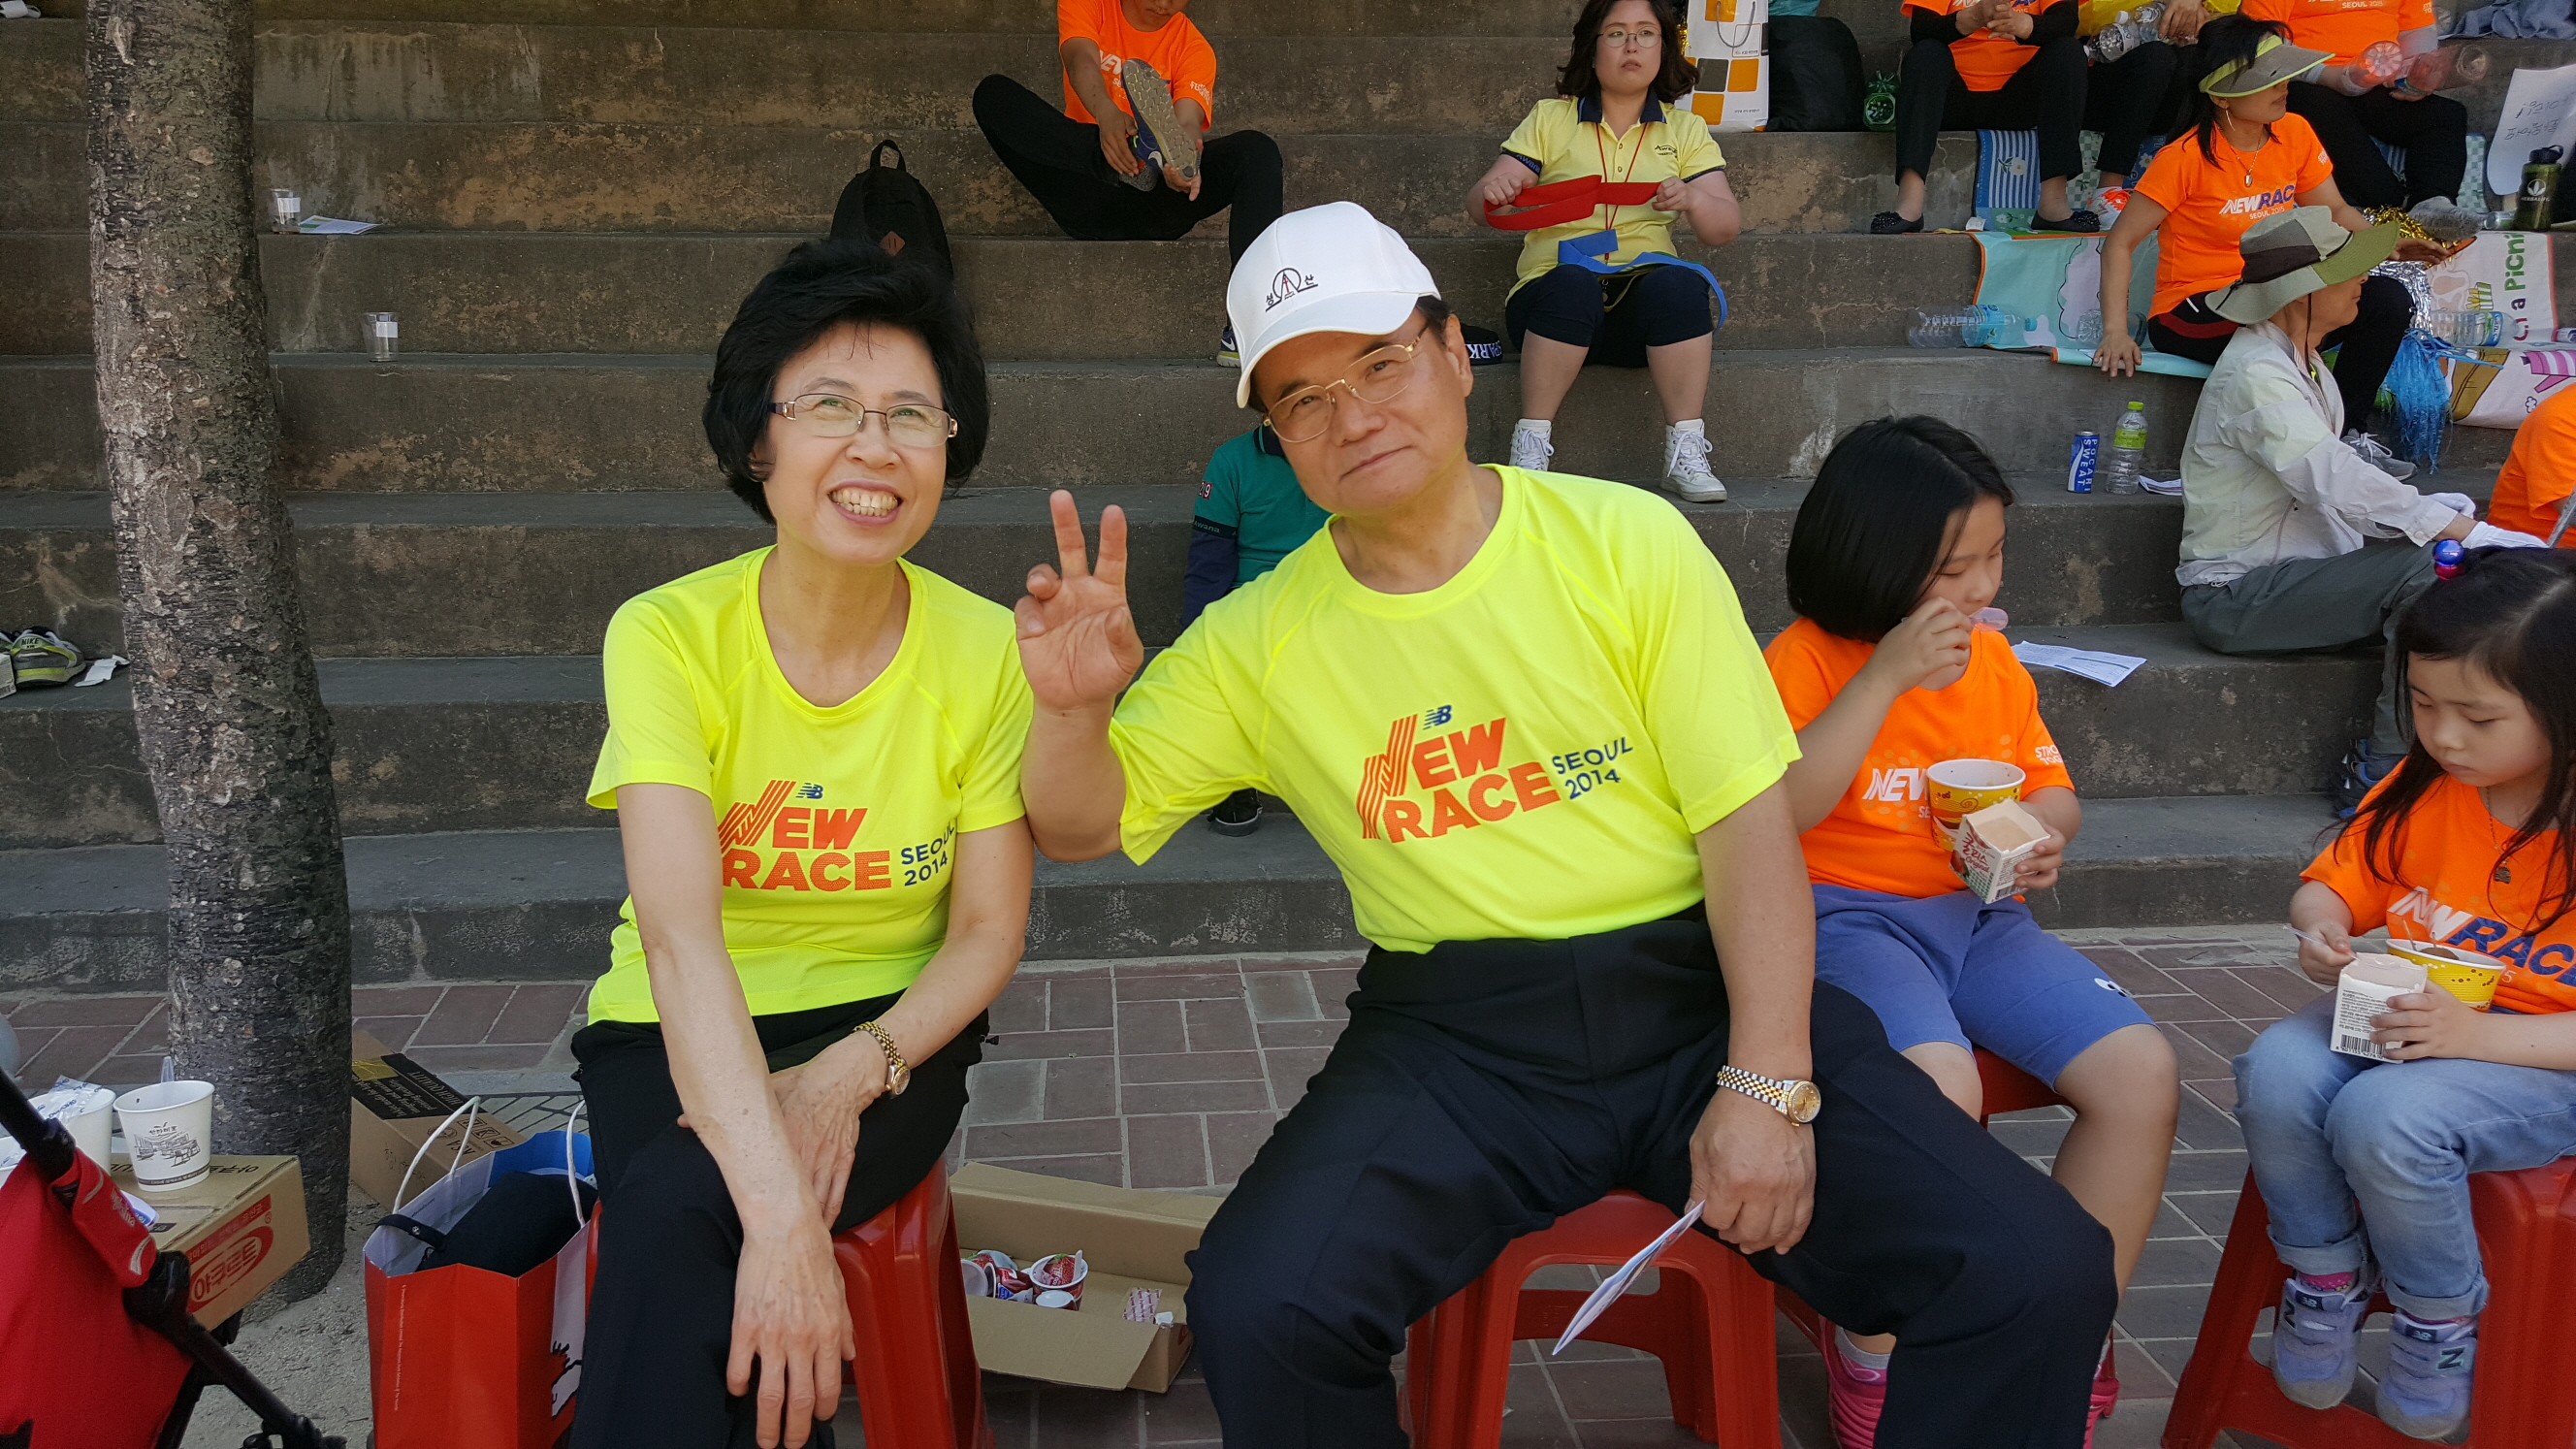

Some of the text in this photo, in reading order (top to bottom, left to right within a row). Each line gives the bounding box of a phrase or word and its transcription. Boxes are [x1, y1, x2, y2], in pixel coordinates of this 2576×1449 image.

[2219, 184, 2295, 215] NEWRAC
[2250, 209, 2270, 220] SEOUL
[2510, 298, 2527, 310] a
[2077, 438, 2091, 486] SWEAT
[2084, 438, 2098, 491] POCARI
[1356, 714, 1506, 840] NEW
[1552, 736, 1633, 775] SEOUL
[1382, 761, 1562, 844] RACE
[1564, 768, 1622, 800] 2014
[900, 821, 955, 865] SEOUL
[722, 848, 892, 892] RACE
[903, 851, 949, 886] 2014
[193, 1235, 259, 1301] 야쿠르트
